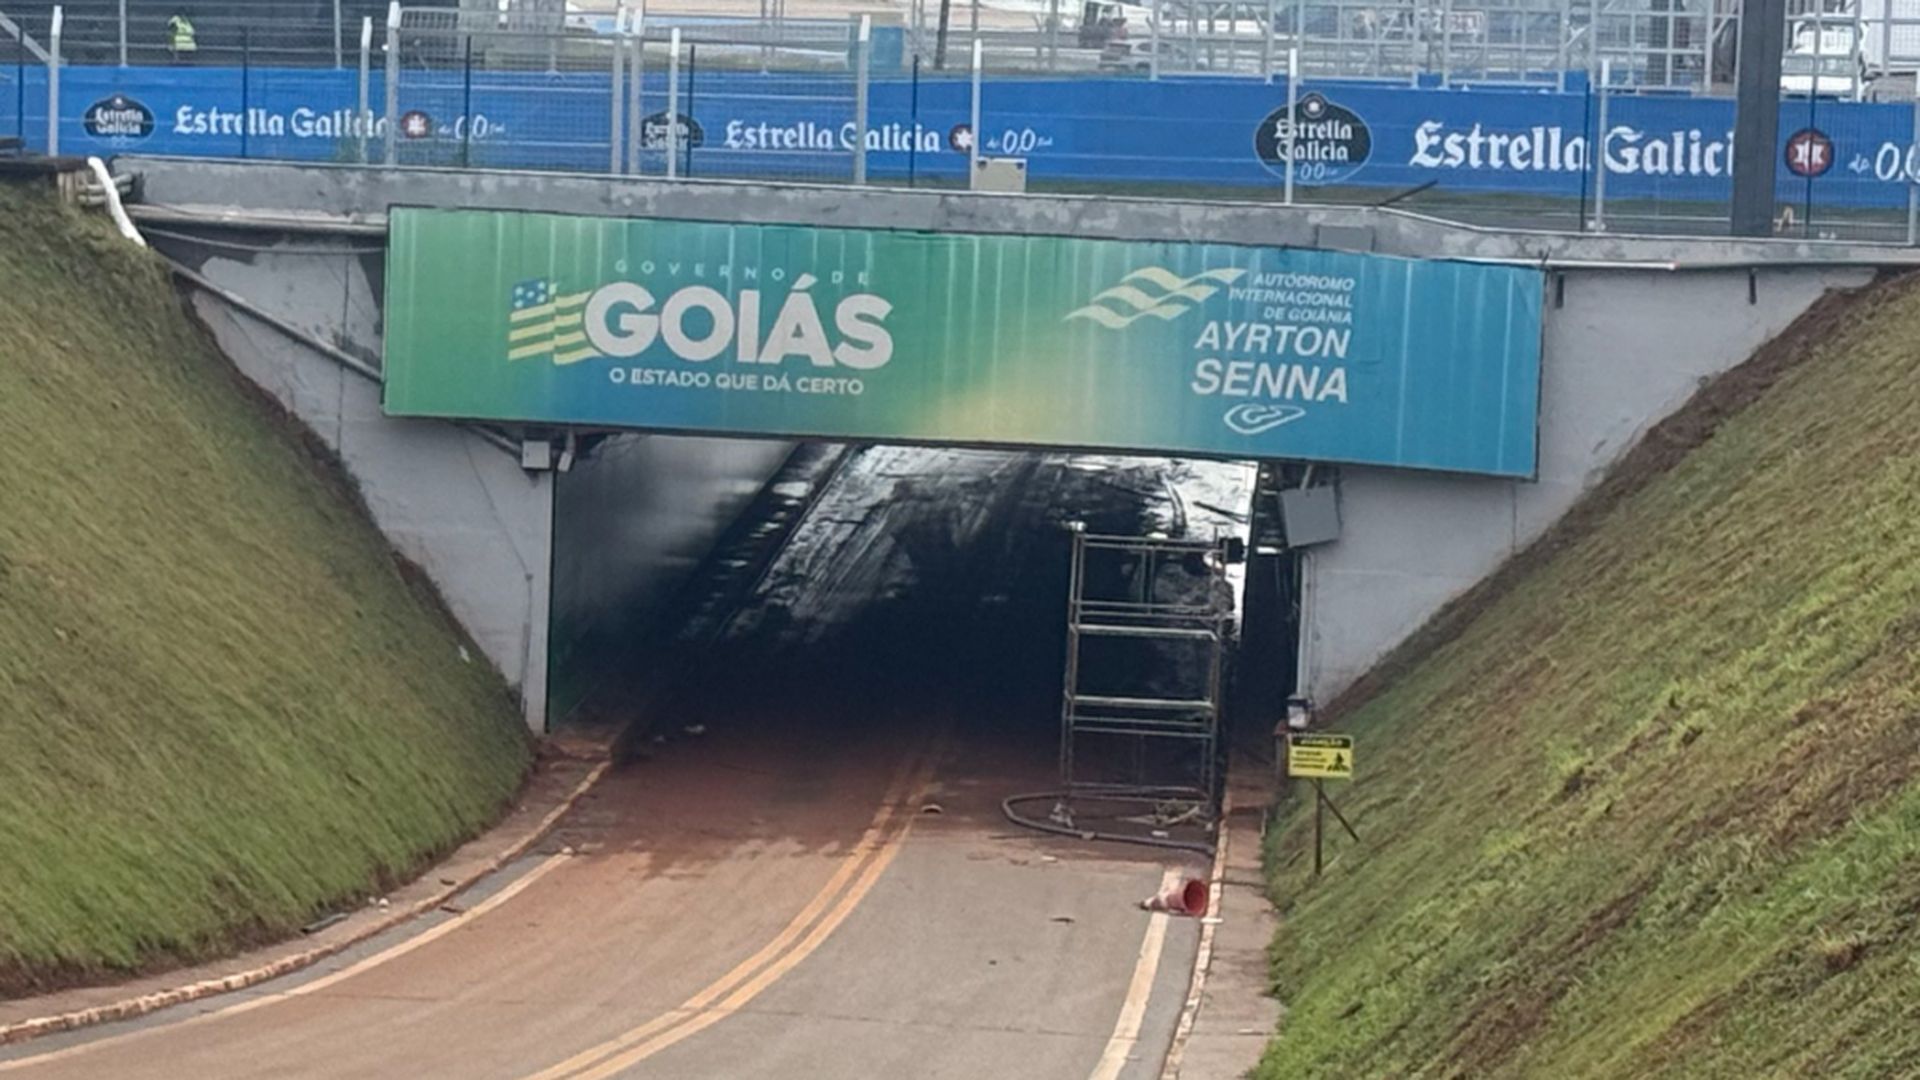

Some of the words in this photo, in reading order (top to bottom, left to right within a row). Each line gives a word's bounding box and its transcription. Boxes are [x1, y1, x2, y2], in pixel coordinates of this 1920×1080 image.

[173, 105, 285, 136] Estrella
[724, 120, 833, 150] Estrella
[840, 122, 940, 152] Galicia
[1409, 120, 1591, 170] Estrella
[614, 259, 785, 282] GOVERNO
[831, 270, 870, 285] DE
[1253, 272, 1356, 291] AUTÓDROMO
[1228, 287, 1354, 308] INTERNACIONAL
[584, 273, 894, 370] GOIÁS
[1263, 306, 1285, 321] DE
[1287, 307, 1353, 324] GOIÂNIA
[1193, 321, 1351, 358] AYRTON
[609, 367, 626, 383] O
[630, 368, 711, 388] ESTADO
[715, 375, 758, 390] QUE
[763, 373, 791, 392] DÁ
[796, 377, 864, 395] CERTO
[1190, 358, 1348, 403] SENNA
